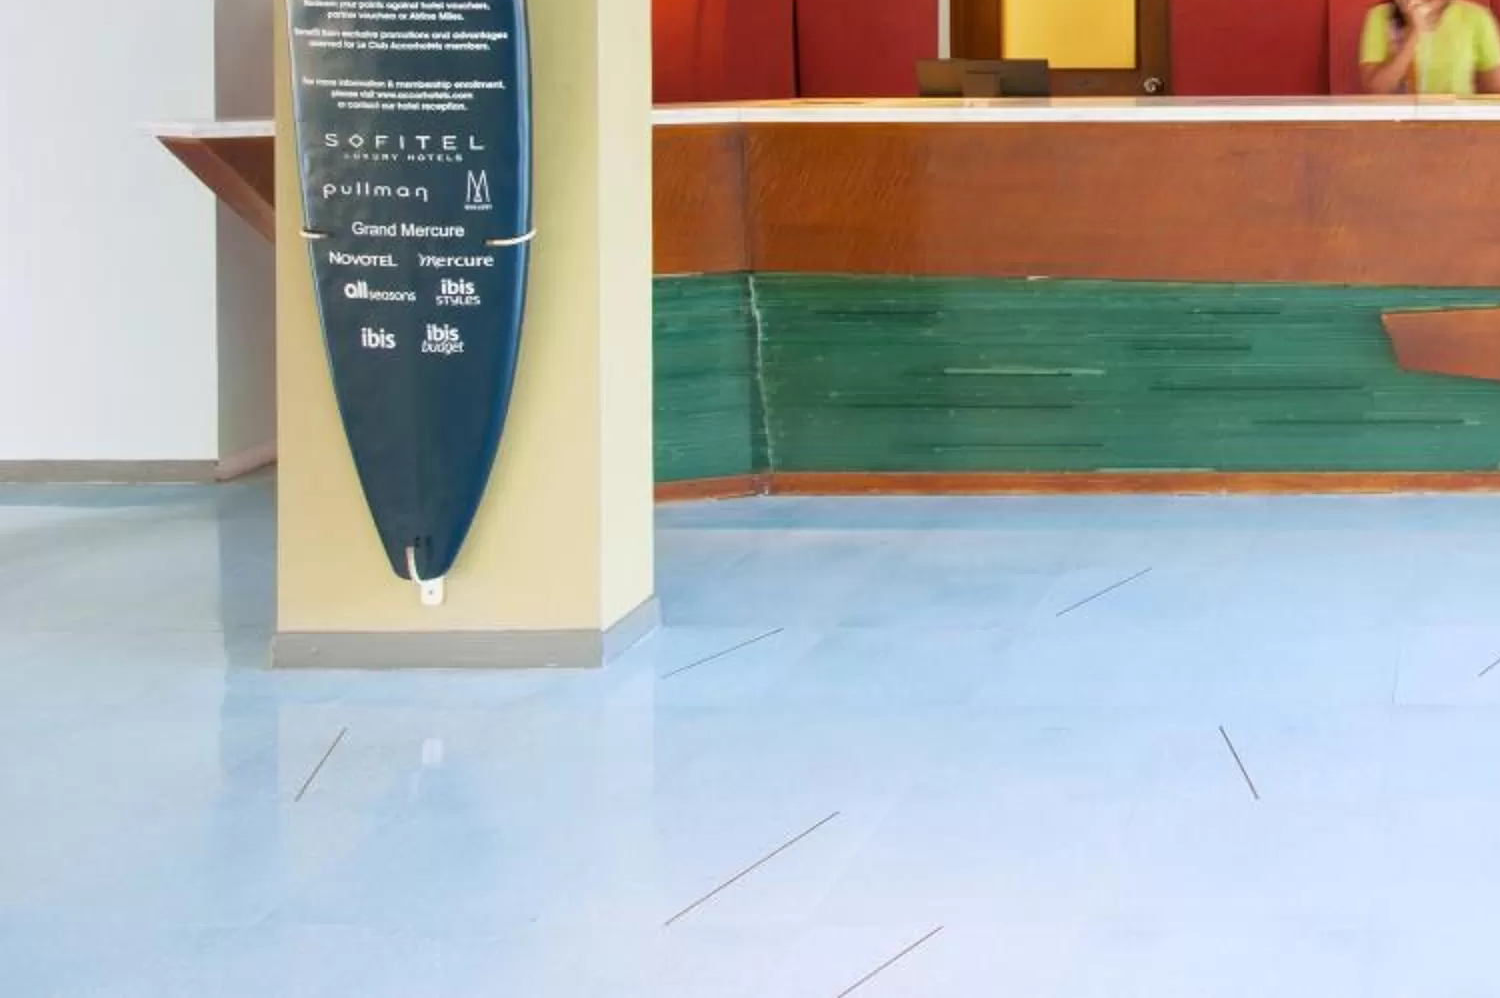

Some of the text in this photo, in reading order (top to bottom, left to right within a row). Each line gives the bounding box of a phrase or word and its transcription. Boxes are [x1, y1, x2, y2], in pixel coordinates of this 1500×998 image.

[325, 133, 485, 151] SOFITEL
[407, 153, 463, 162] HOTELS
[323, 181, 429, 203] pullman
[352, 221, 465, 239] Grand Mercure
[329, 251, 399, 267] NOVOTEL
[441, 278, 475, 295] ibis
[361, 327, 396, 350] ibis
[426, 323, 460, 343] ibis
[421, 339, 464, 356] budget
